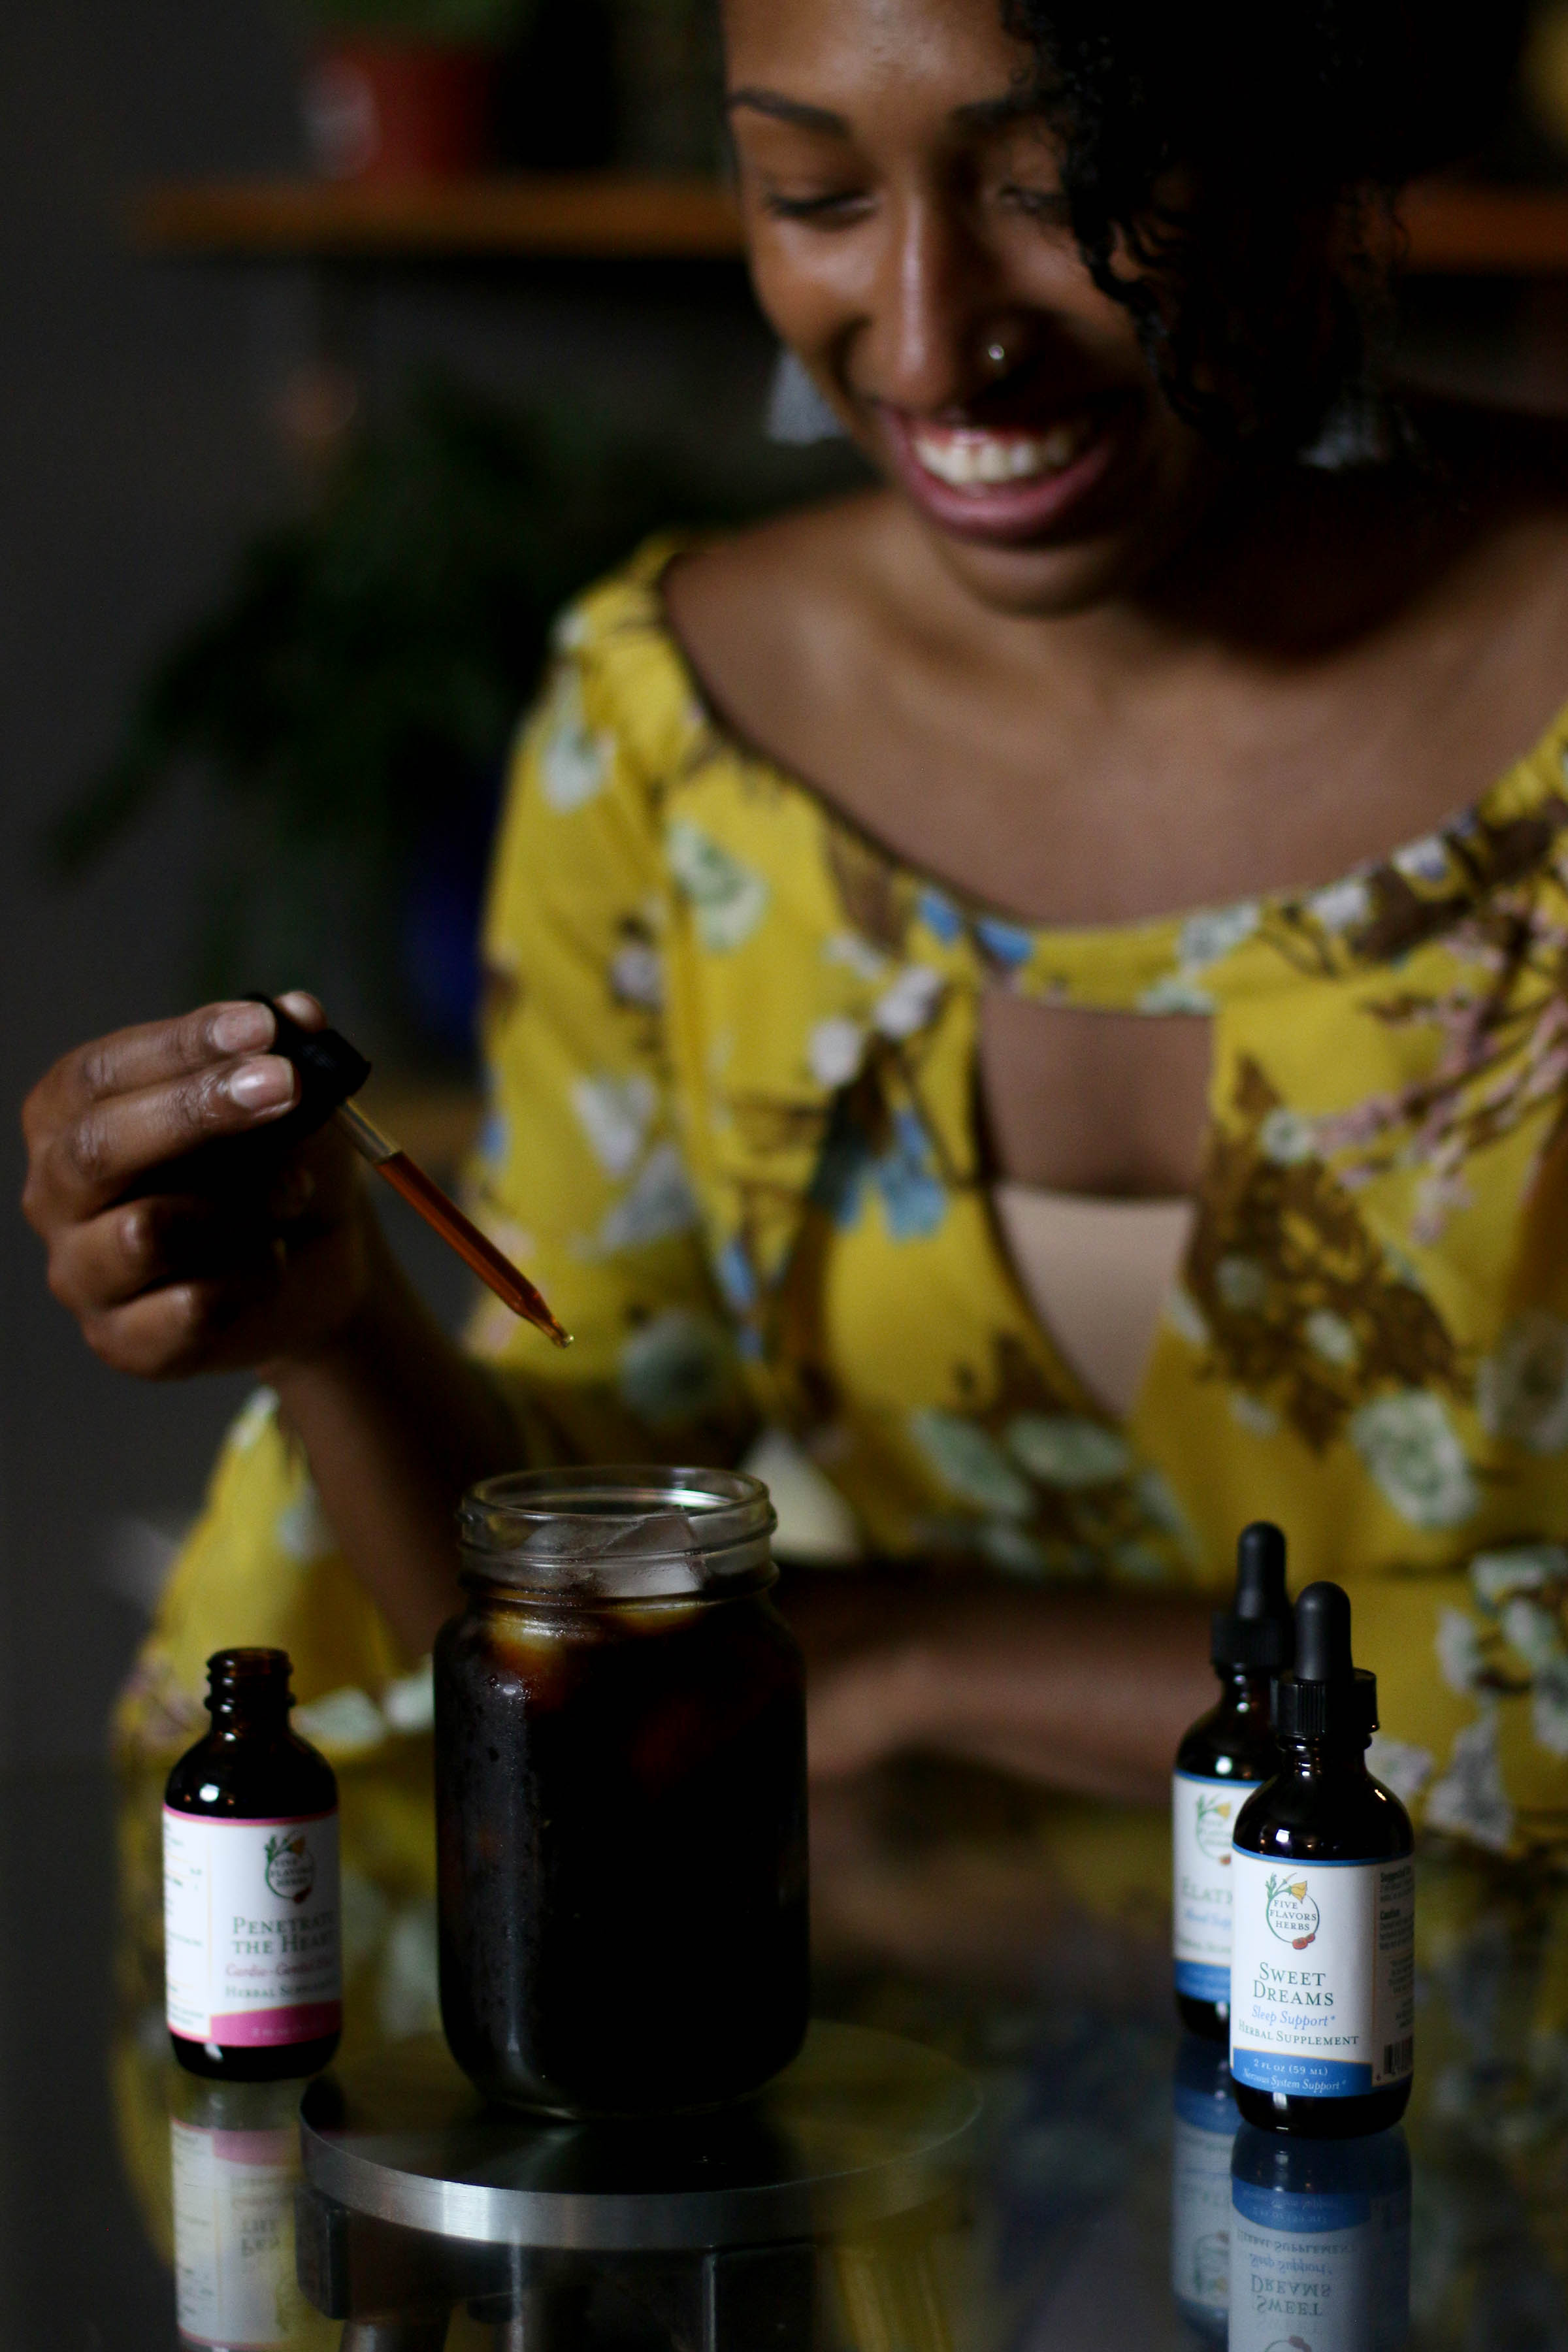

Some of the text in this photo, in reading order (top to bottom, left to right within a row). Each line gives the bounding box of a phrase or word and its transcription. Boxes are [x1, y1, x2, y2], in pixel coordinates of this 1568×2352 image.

[1273, 1899, 1297, 1909] FIVE
[1269, 1909, 1317, 1921] FLAVORS
[1275, 1920, 1310, 1931] HERBS
[230, 1940, 272, 1954] THE
[1260, 1961, 1326, 1986] SWEET
[1253, 1980, 1334, 2006] DREAMS
[1252, 2004, 1277, 2026] Sleep
[1239, 2019, 1360, 2046] HERBAL SUPPLEMENT
[1271, 2075, 1300, 2089] System
